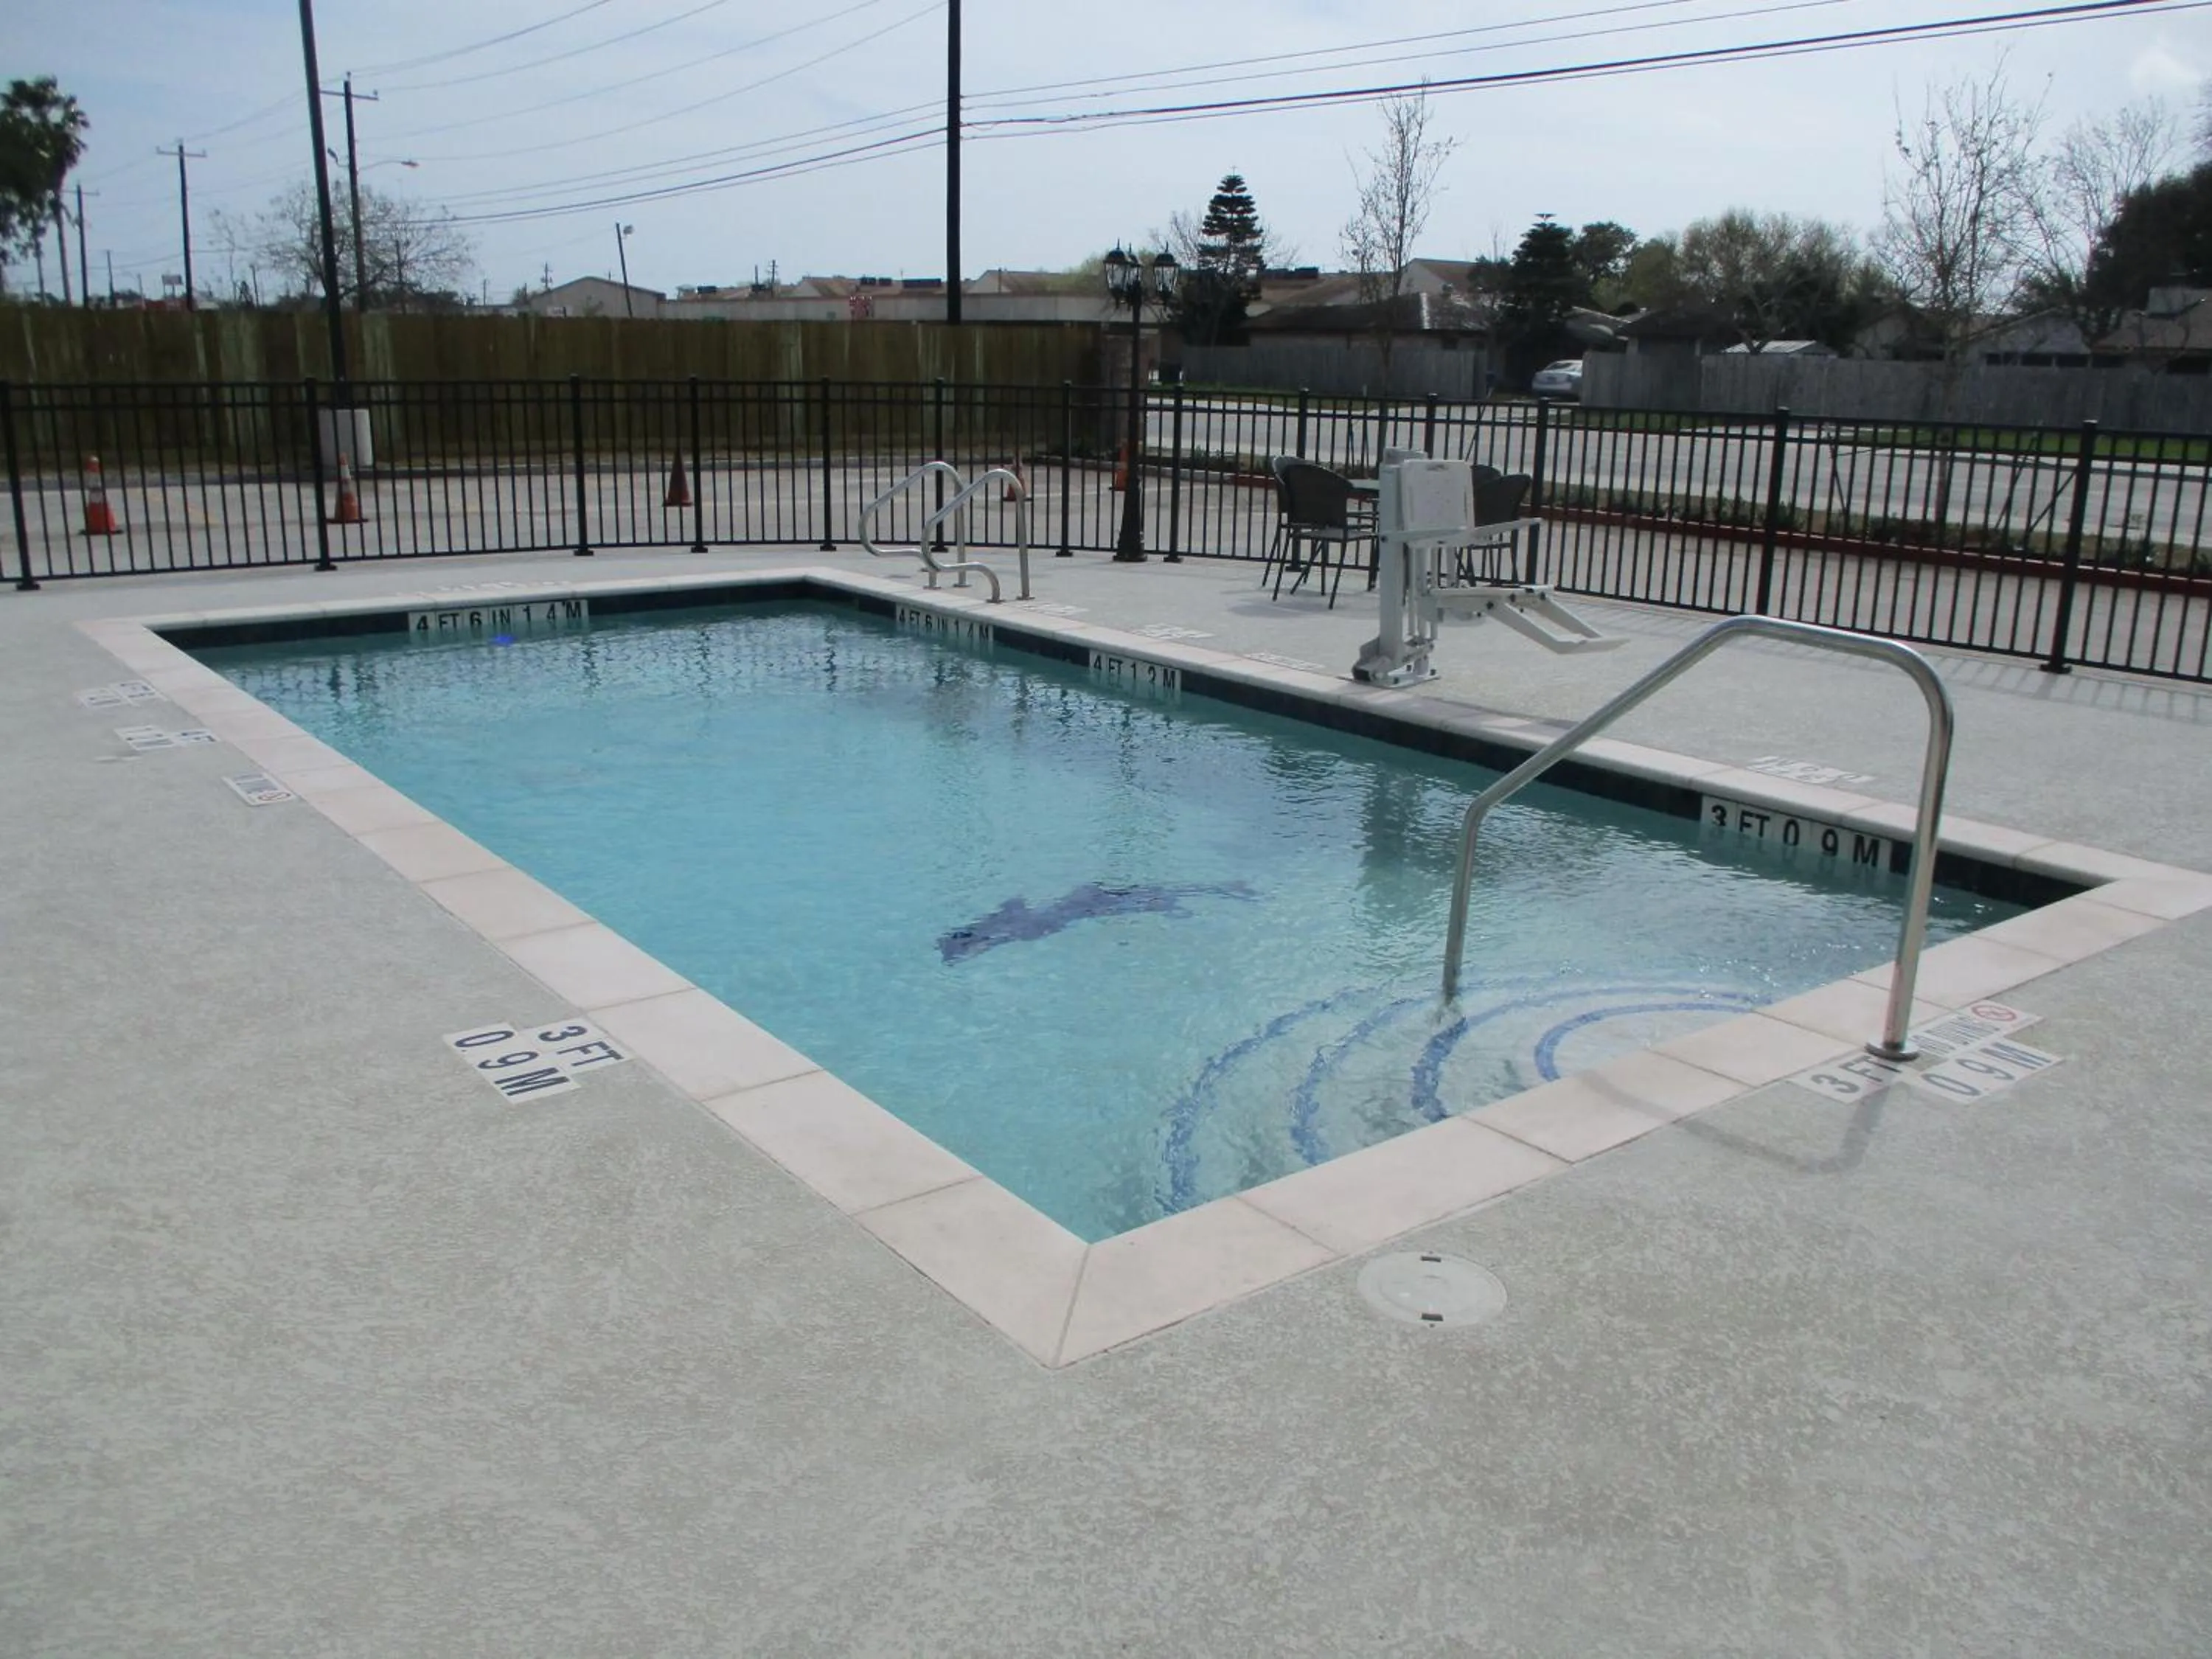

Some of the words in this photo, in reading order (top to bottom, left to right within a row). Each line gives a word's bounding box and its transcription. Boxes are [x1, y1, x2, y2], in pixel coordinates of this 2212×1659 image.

[417, 615, 428, 630] 4
[437, 613, 460, 628] FT
[469, 611, 482, 628] 6
[492, 608, 510, 628] IN
[909, 609, 920, 626] FT
[1093, 654, 1102, 670] 4
[1108, 657, 1123, 675] FT
[1163, 668, 1175, 689] M
[1711, 805, 1727, 827] 3
[1739, 810, 1770, 838] FT
[1853, 835, 1879, 866] M
